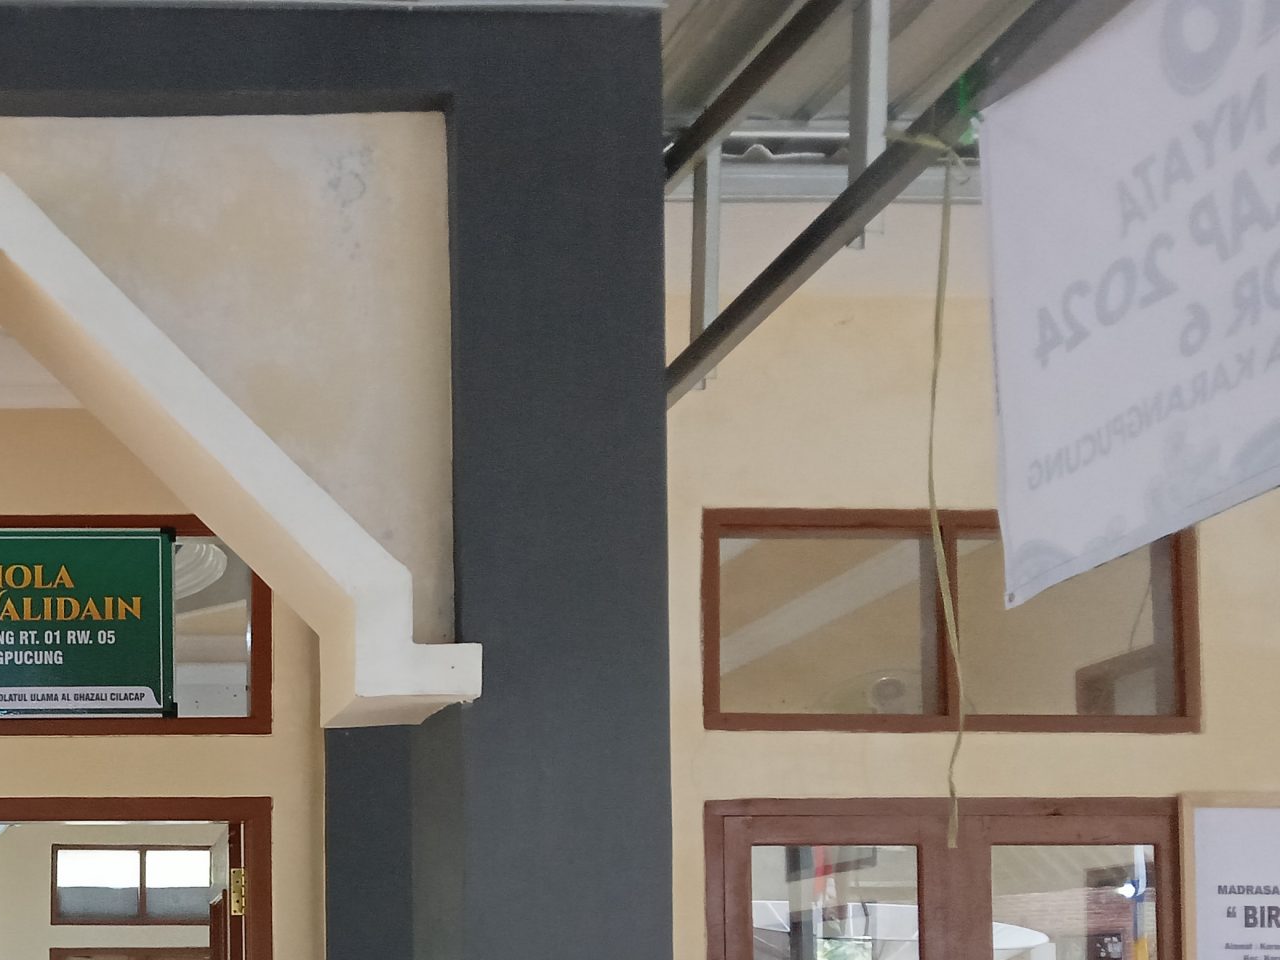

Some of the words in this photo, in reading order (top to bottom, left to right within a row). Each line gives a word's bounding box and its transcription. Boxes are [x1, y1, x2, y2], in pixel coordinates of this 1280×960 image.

[19, 631, 40, 645] RT.
[44, 630, 61, 645] 01
[67, 630, 93, 645] RW.
[97, 630, 116, 645] 05
[31, 693, 59, 702] ULAMA
[61, 693, 70, 702] AL
[73, 692, 108, 702] GHAZALI
[110, 692, 146, 702] CILACAP
